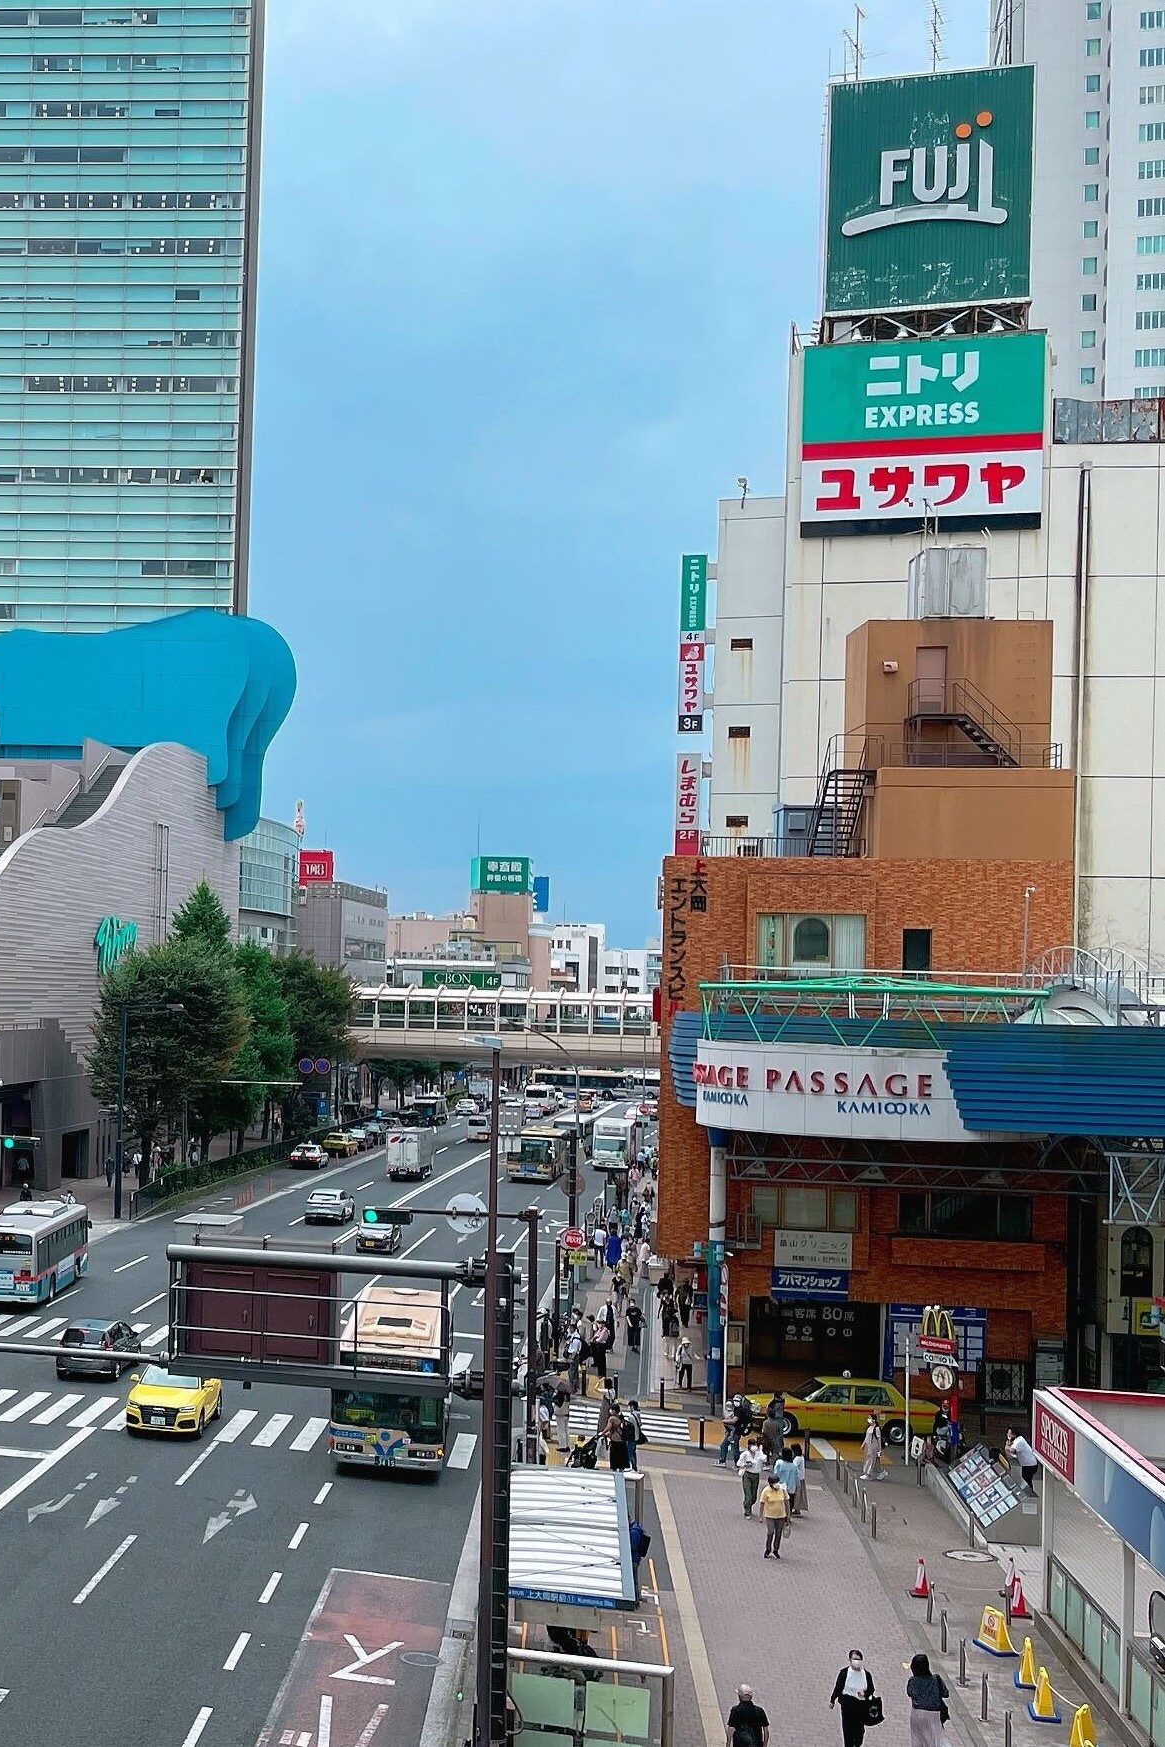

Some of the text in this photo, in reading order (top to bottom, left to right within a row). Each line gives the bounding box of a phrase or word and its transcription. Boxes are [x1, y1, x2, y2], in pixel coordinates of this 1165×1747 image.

[866, 351, 980, 397] ニトリ
[864, 401, 980, 429] EXPRESS
[815, 462, 1027, 512] ユザワヤ
[689, 559, 700, 594] ニトリ
[688, 596, 698, 629] EXPRESS
[685, 632, 700, 642] 4F
[684, 663, 698, 713] ユザワヤ
[682, 718, 699, 731] 3F
[678, 759, 697, 825] しまむら
[679, 830, 696, 840] 2F
[689, 859, 709, 913] 上大岡
[486, 976, 500, 987] 4F
[766, 1068, 933, 1098] PASSAGE
[837, 1100, 931, 1116] KAMIOOKA
[778, 1274, 841, 1288] アパマンショップ
[1041, 1412, 1068, 1456] SPORTS
